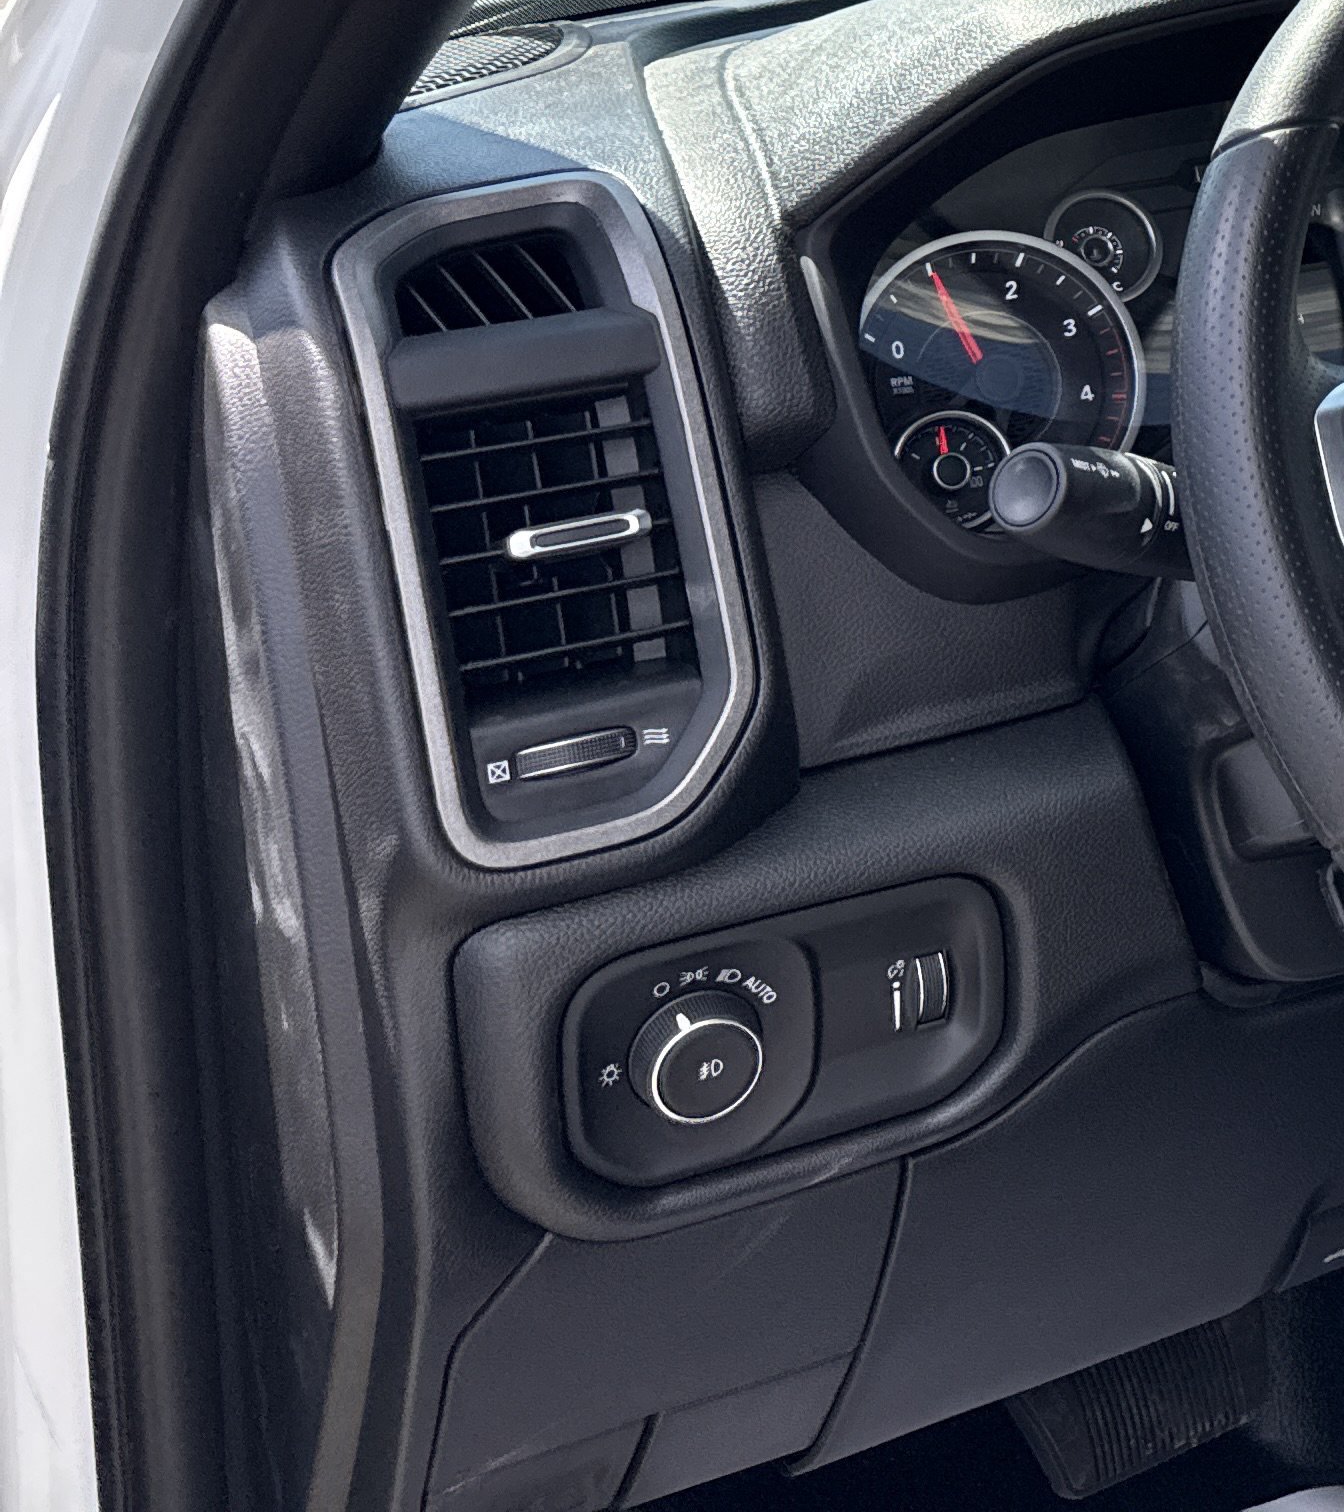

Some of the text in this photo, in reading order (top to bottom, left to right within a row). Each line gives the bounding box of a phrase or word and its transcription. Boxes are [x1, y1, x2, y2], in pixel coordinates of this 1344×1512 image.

[1311, 203, 1321, 216] N
[1004, 280, 1018, 300] 2
[1112, 280, 1124, 292] C
[1062, 319, 1077, 337] 3
[892, 340, 905, 360] 0
[890, 375, 913, 388] RPM
[1080, 384, 1094, 402] 4
[1164, 520, 1180, 532] OFF
[742, 975, 778, 1005] AUTO
